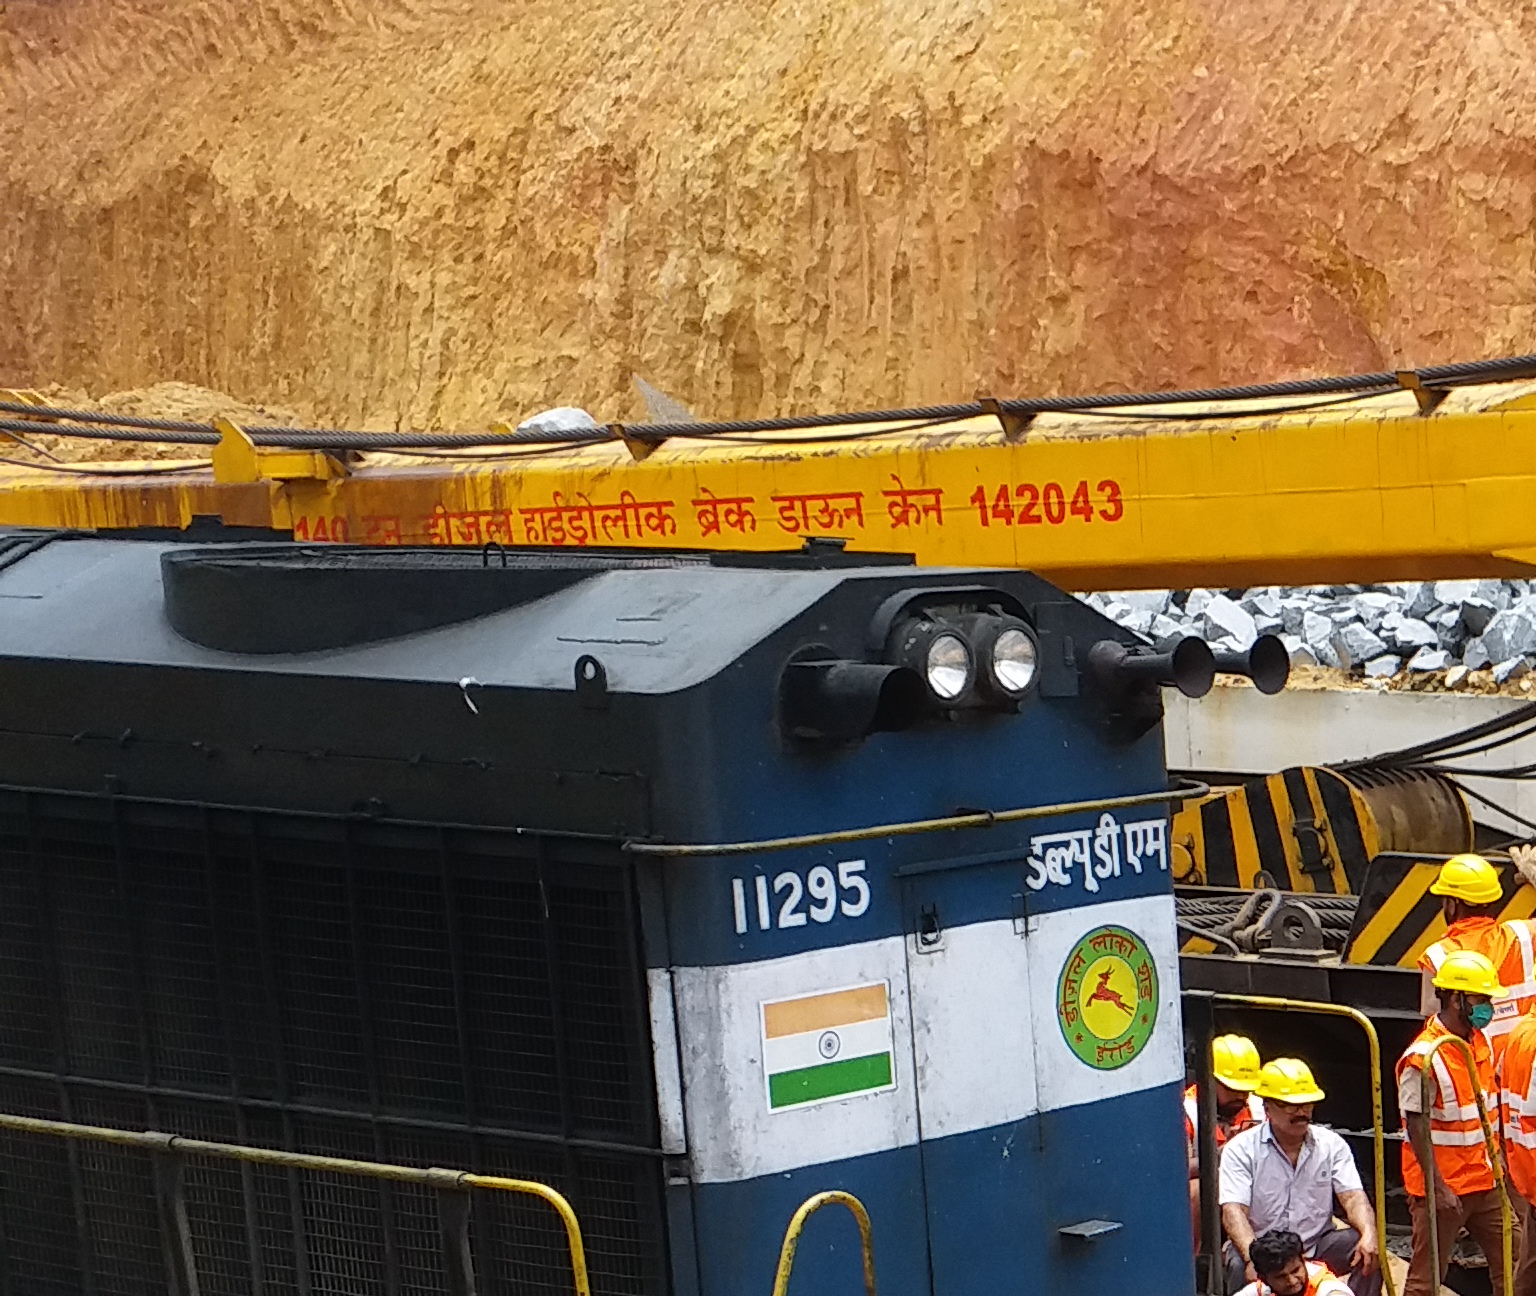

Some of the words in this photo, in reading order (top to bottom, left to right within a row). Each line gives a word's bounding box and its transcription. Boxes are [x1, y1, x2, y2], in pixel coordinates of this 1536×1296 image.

[692, 486, 758, 538] ब्रेक
[770, 490, 865, 532] डाऊन
[881, 473, 944, 529] क्रेन
[970, 478, 1125, 527] 142043
[731, 859, 872, 935] 11295
